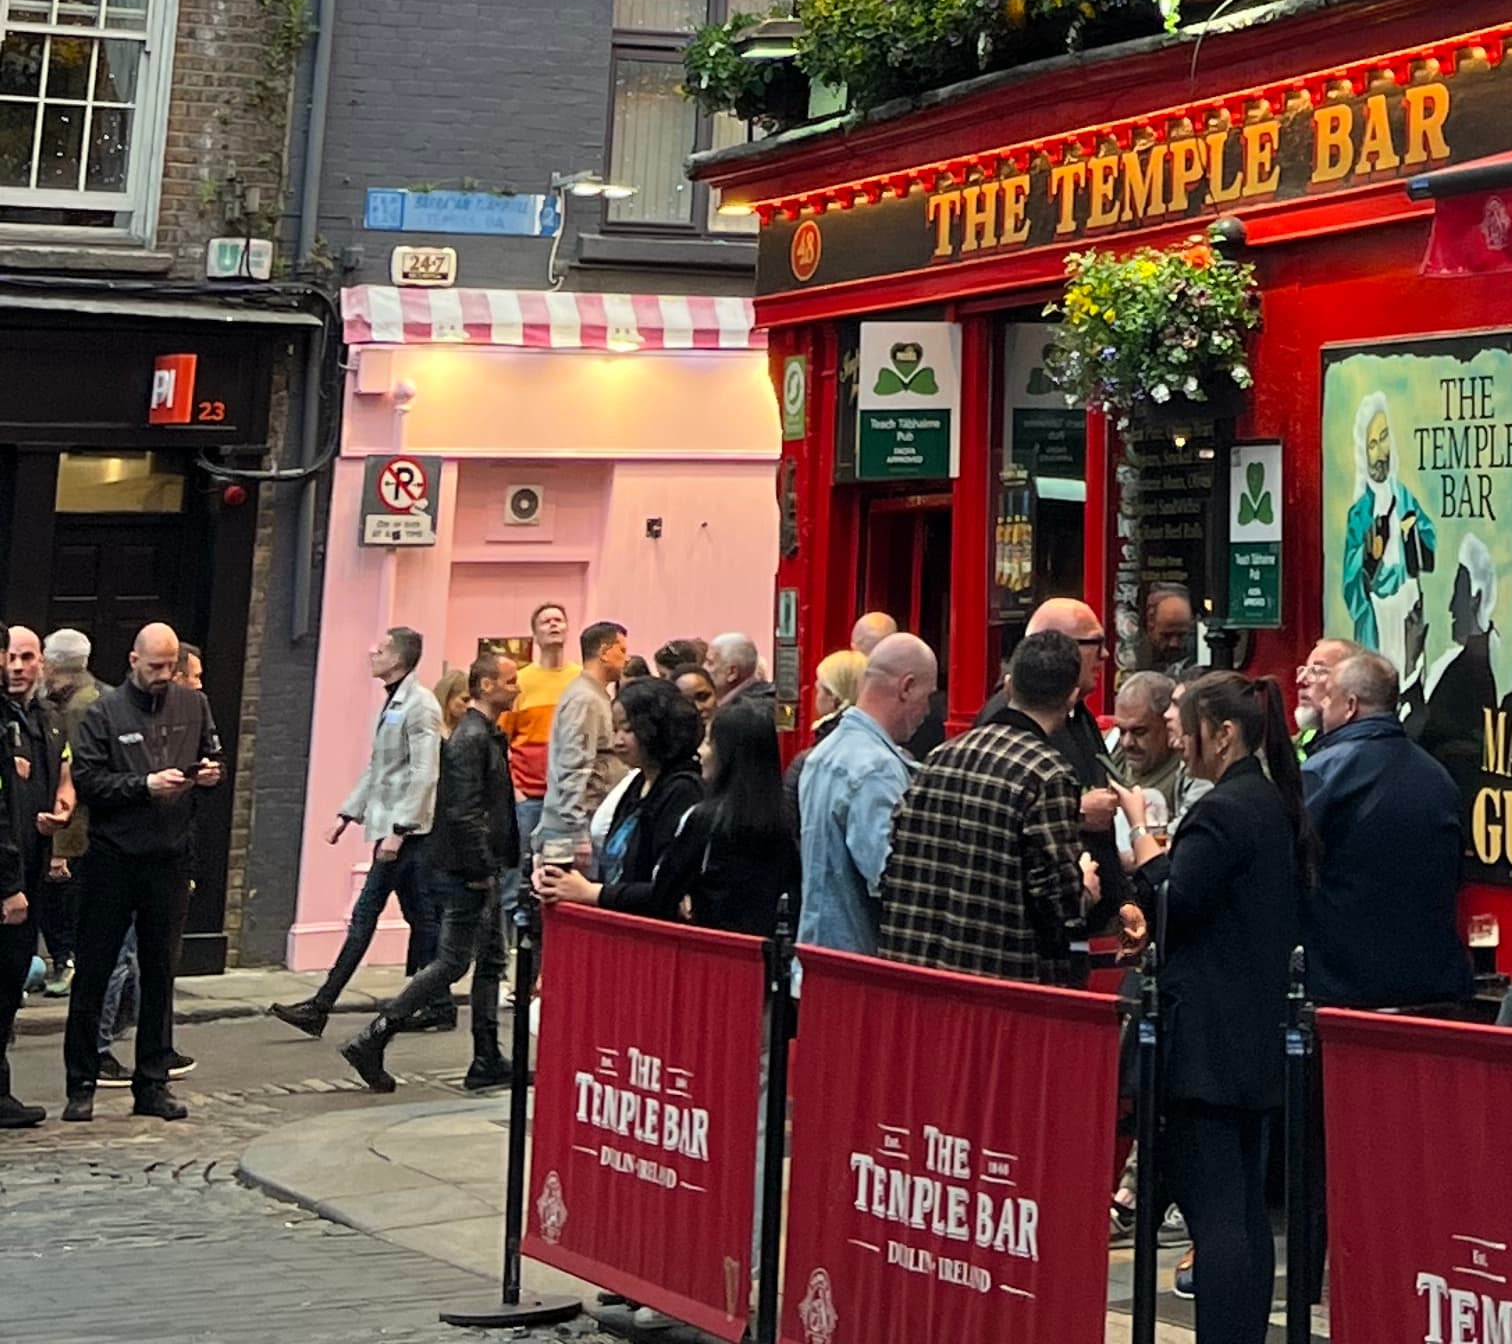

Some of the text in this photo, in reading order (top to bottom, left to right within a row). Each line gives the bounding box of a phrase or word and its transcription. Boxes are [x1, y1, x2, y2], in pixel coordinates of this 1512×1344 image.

[927, 81, 1452, 259] THE TEMPLE BAR
[797, 230, 815, 265] 48
[198, 402, 225, 421] 23
[1440, 375, 1495, 421] THE
[1440, 473, 1497, 521] BAR
[627, 1046, 662, 1092] THE
[575, 1071, 710, 1162] TEMPLE BAR
[923, 1124, 971, 1179] THE
[850, 1152, 1040, 1263] TEMPLE BAR
